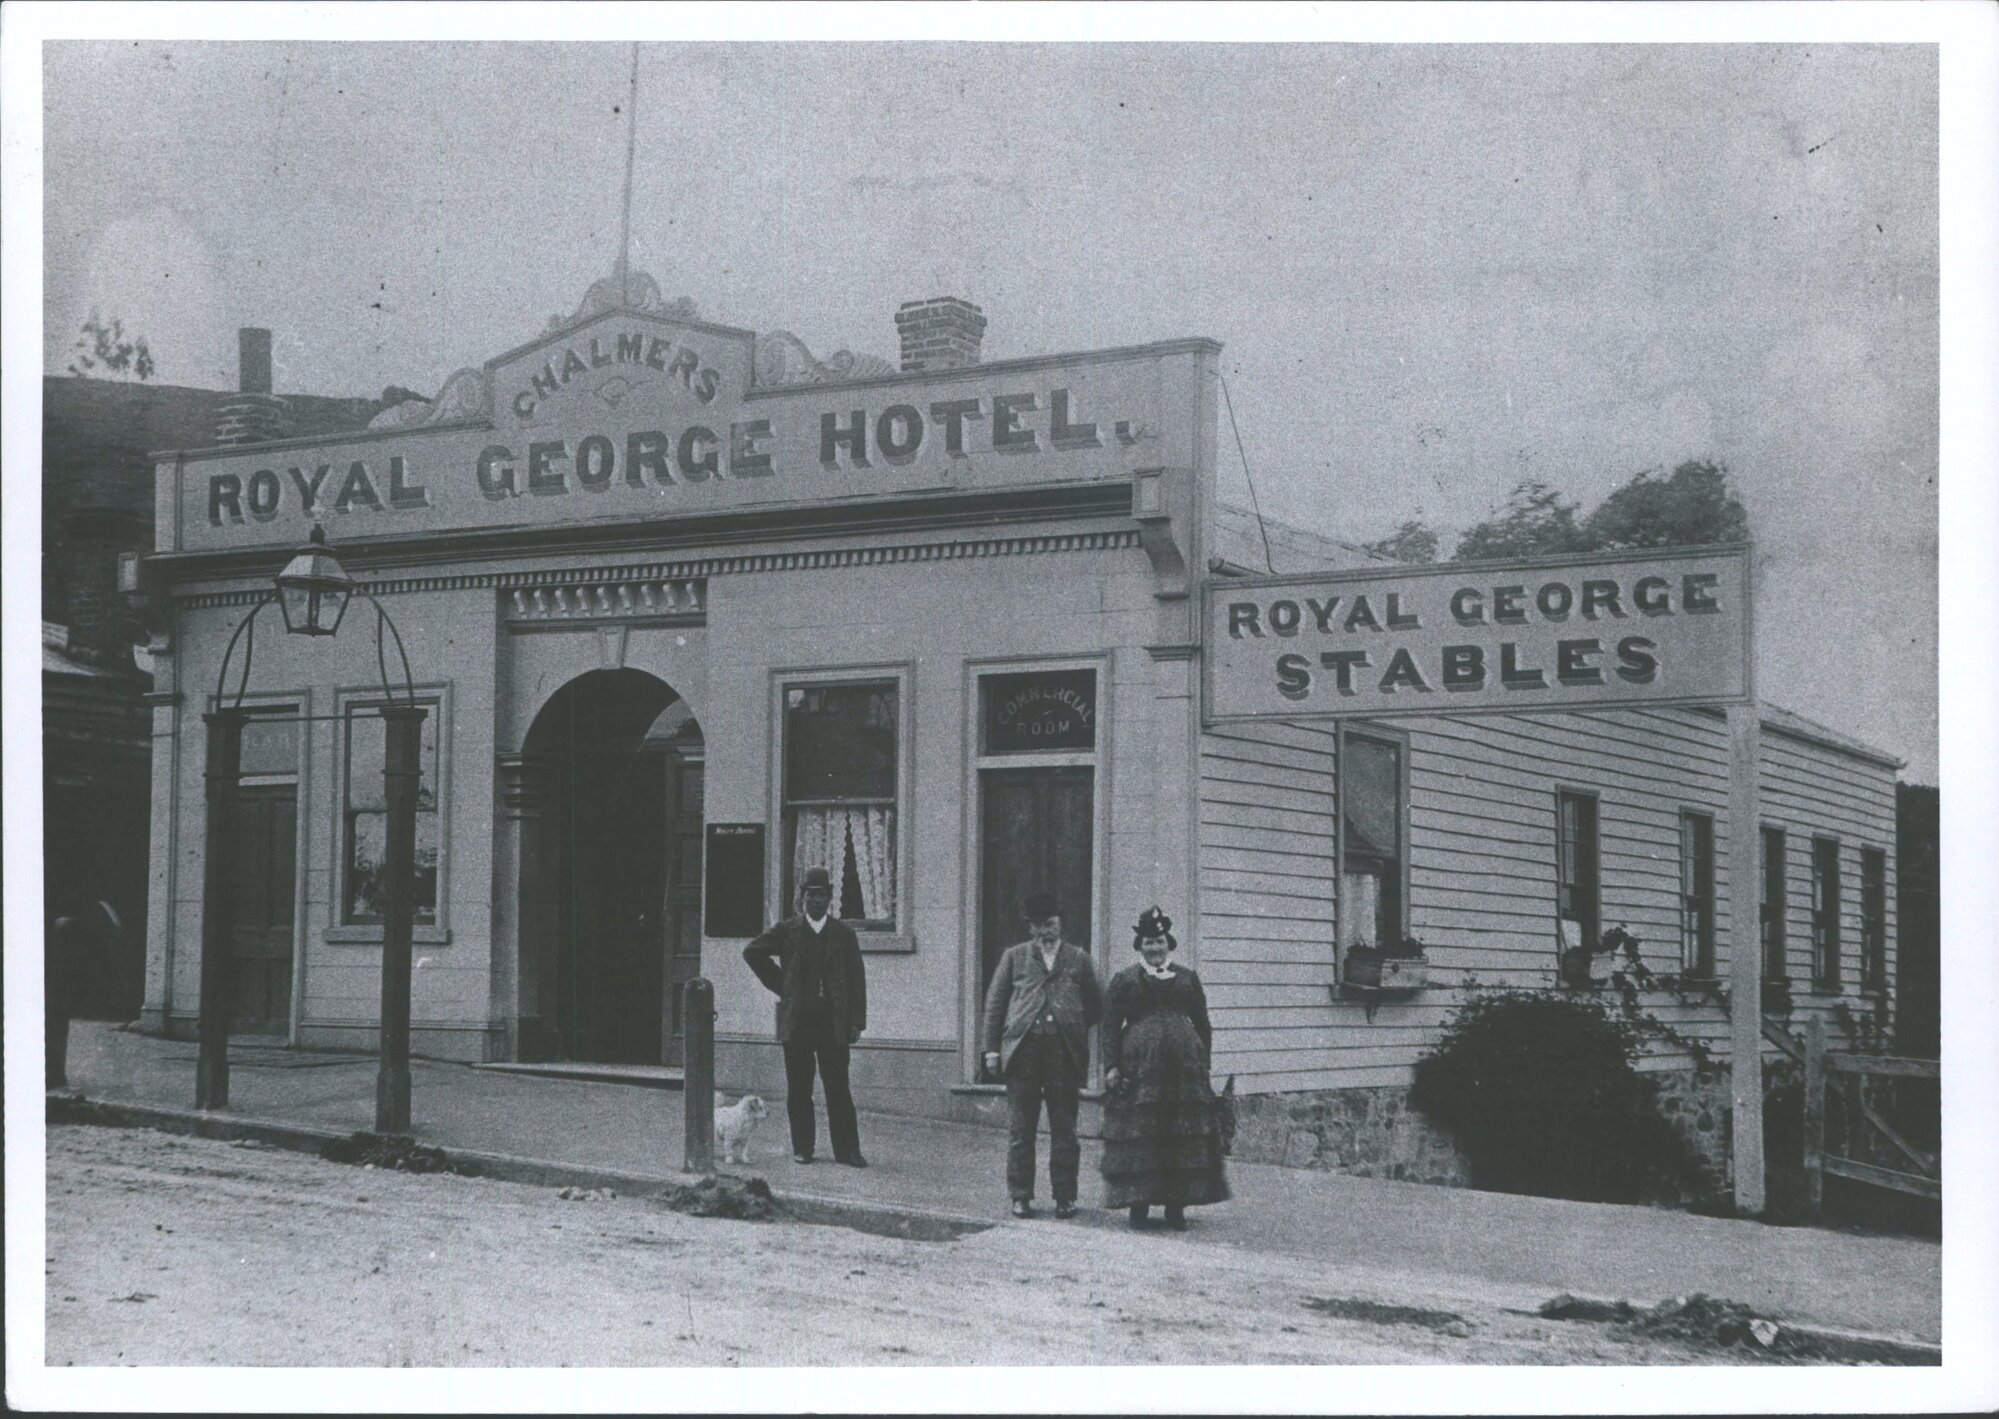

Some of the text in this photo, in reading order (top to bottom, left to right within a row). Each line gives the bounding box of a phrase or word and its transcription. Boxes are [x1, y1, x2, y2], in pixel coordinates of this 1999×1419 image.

[513, 332, 721, 419] CHALMERS
[208, 455, 430, 526] ROYAL
[476, 418, 777, 501] GEORGE
[1228, 573, 1723, 639] ROYAL GEORGE
[1275, 635, 1661, 701] STABLES
[998, 686, 1092, 725] COMMERCIAL
[1016, 720, 1070, 736] ROOM
